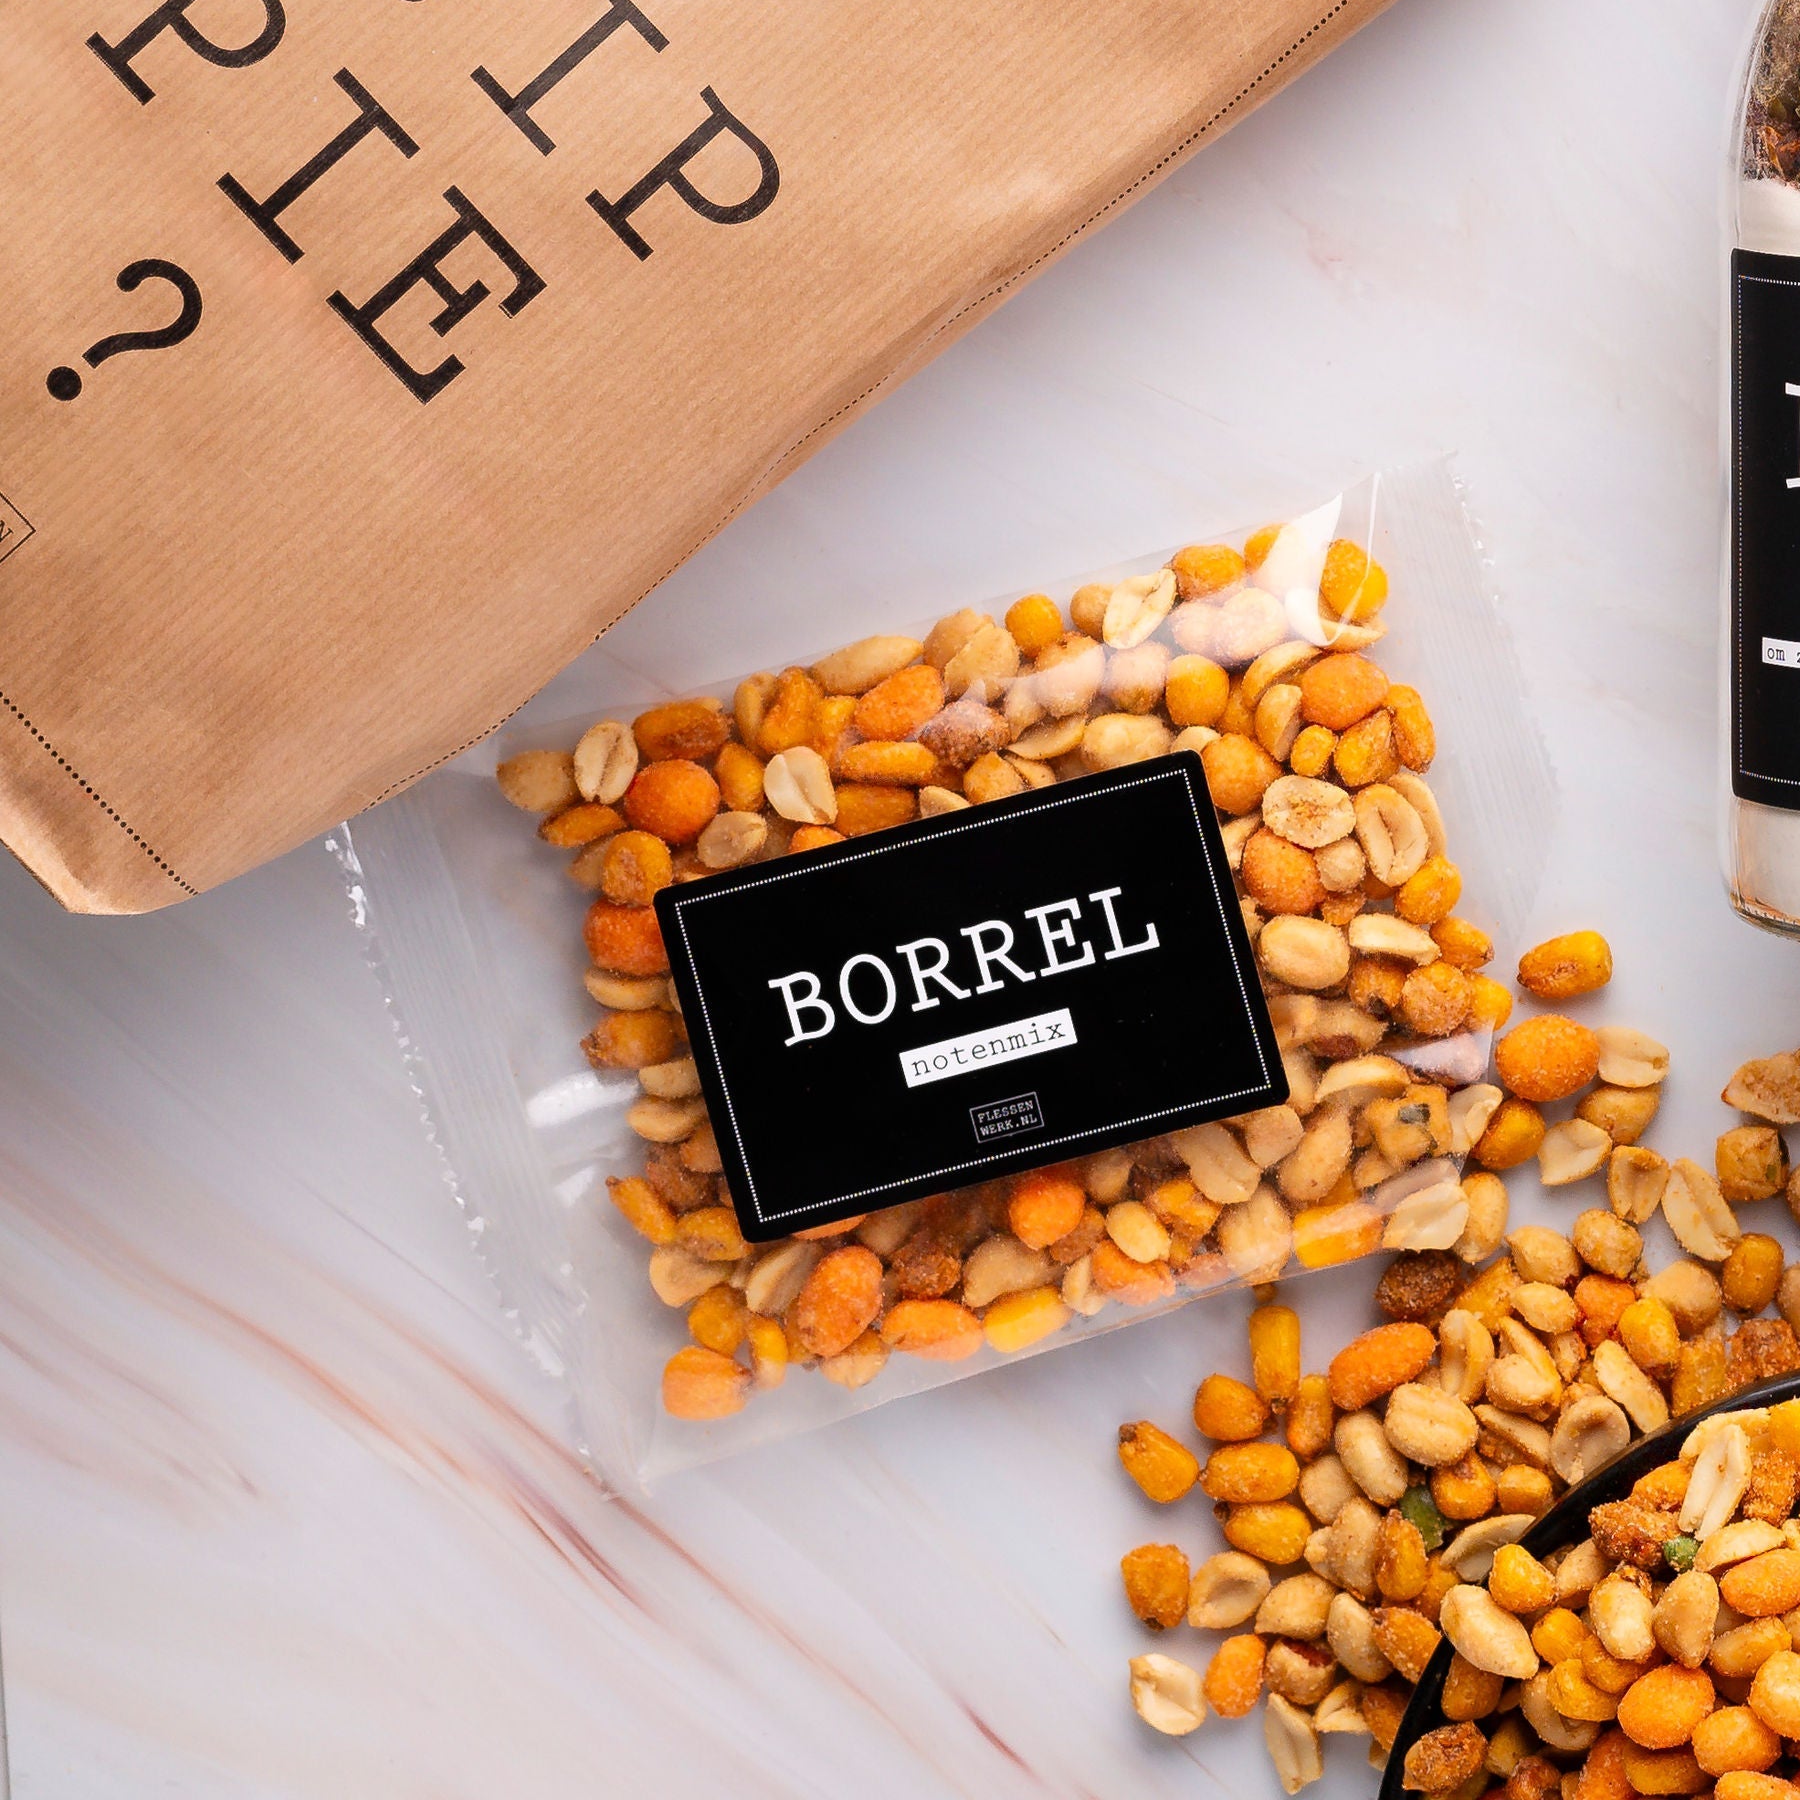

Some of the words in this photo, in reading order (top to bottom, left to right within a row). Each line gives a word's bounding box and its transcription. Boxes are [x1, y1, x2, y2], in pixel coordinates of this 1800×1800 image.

[45, 257, 204, 402] ?
[1766, 646, 1786, 662] om
[767, 886, 1161, 1047] BORREL
[910, 1019, 1068, 1079] notenmix
[977, 1100, 1034, 1124] FLESSEN
[979, 1114, 1038, 1137] WERK.NL
